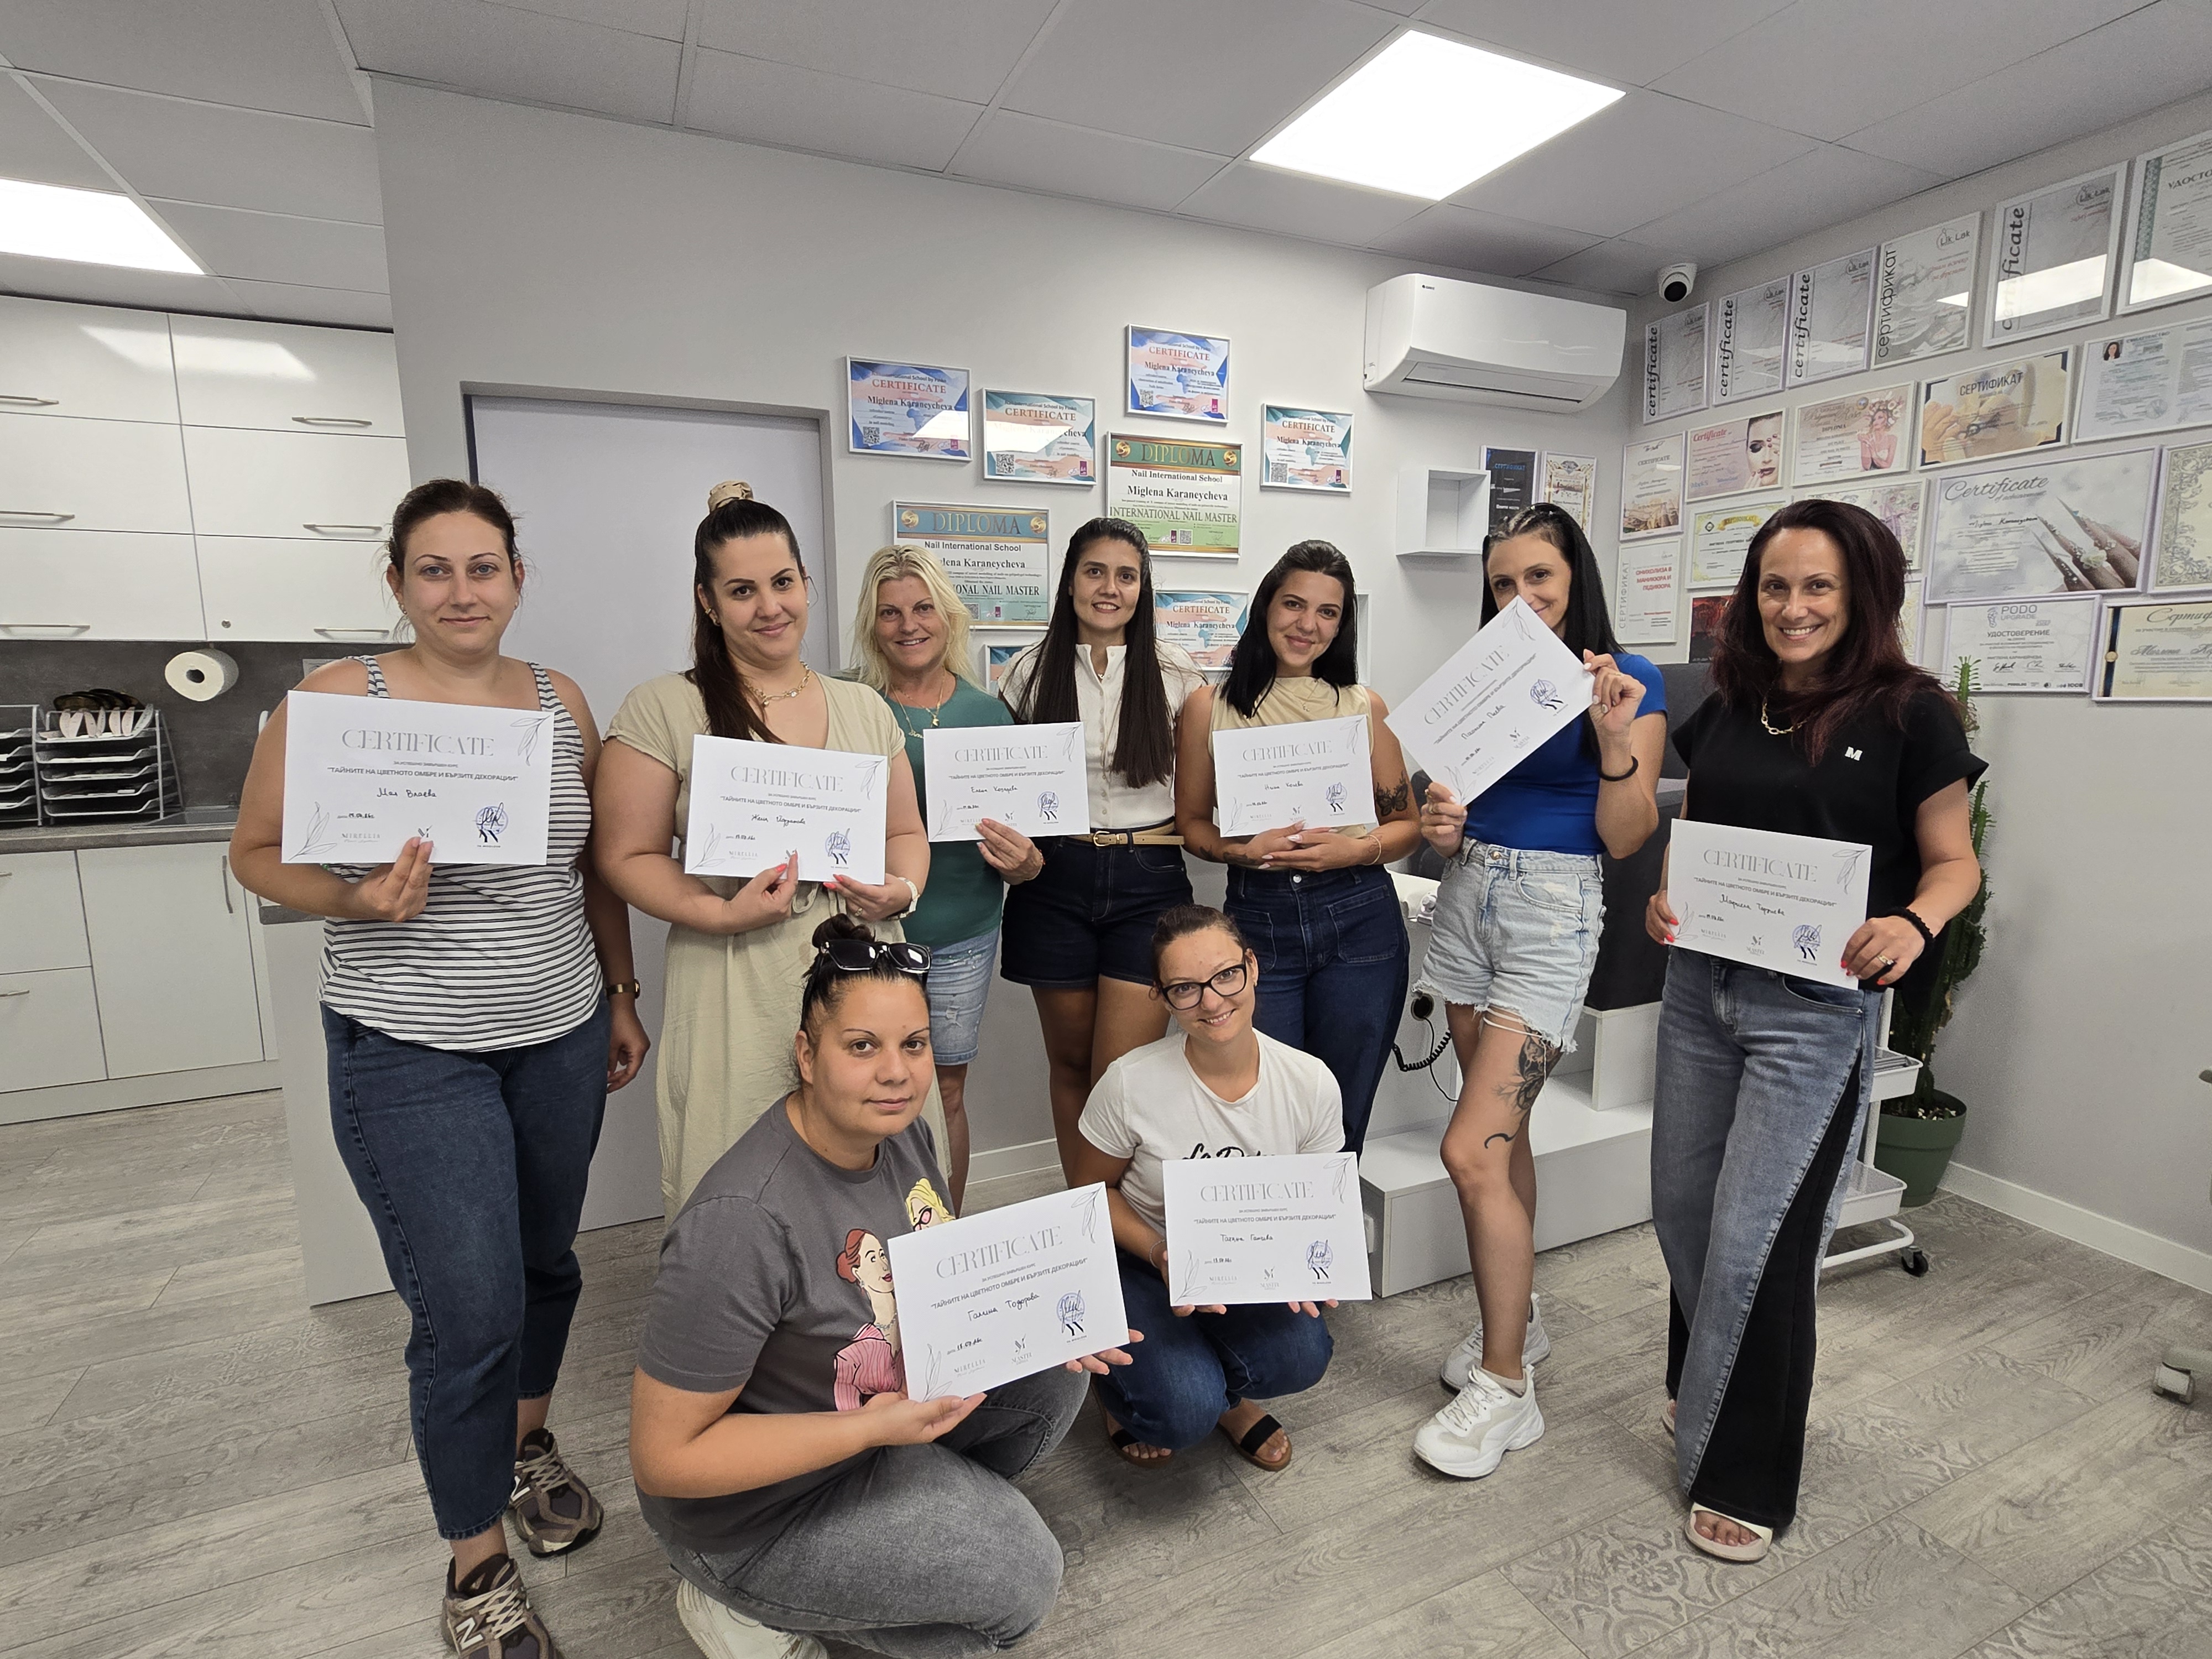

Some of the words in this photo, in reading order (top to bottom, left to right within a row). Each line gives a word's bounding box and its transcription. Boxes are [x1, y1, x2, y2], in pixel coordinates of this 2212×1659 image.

[1878, 250, 1897, 358] сертификат
[1793, 274, 1811, 378] certificate
[1149, 346, 1210, 361] CERTIFICATE
[1720, 299, 1734, 397] certificate
[1145, 361, 1170, 371] Miglena
[1646, 326, 1658, 418] certificate
[872, 379, 946, 394] CERTIFICATE
[1959, 372, 2024, 396] СЕРТИФИКАТ
[868, 395, 898, 405] Miglena
[1005, 408, 1076, 421] CERTIFICATE
[1282, 420, 1335, 433] CERTIFICATE
[1693, 429, 1728, 442] Certificate
[1141, 444, 1215, 467] DIPLOMA
[1637, 455, 1671, 466] CERTIFICATE
[1131, 469, 1147, 478] Nail
[1149, 470, 1197, 481] International
[1199, 474, 1223, 483] School
[1128, 485, 1164, 498] Miglena
[1166, 488, 1228, 502] Karaneycheva
[1945, 477, 2049, 501] Certificate
[1110, 507, 1180, 520] INTERNATIONAL
[1183, 511, 1203, 521] NAIL
[1205, 512, 1238, 523] MASTER
[933, 512, 1021, 535] DIPLOMA
[942, 542, 992, 551] International
[994, 544, 1021, 552] School
[964, 558, 1026, 570] Karaneycheva
[982, 585, 1003, 595] NAIL
[1006, 586, 1040, 596] MASTER
[1619, 562, 1629, 629] СЕРТИФИКАТ
[1173, 605, 1230, 614] CERTIFICATE
[2001, 604, 2038, 614] PODO
[1987, 629, 2051, 638] УДОСТОВЕРЕНИЕ
[1425, 645, 1509, 724] CERTIFICATE
[342, 730, 494, 756] CERTIFICATE
[1243, 740, 1332, 761] CERTIFICATE
[954, 745, 1047, 761] CERTIFICATE
[1845, 746, 1863, 761] M
[731, 766, 843, 792] CERTIFICATE
[1703, 850, 1817, 881] CERTIFICATE
[1201, 1182, 1313, 1201] CERTIFICATE
[936, 1226, 1062, 1278] CERTIFICATE
[970, 1284, 1000, 1297] ЦВЕТНОТО
[1001, 1277, 1020, 1287] ОМБРЕ
[1026, 1268, 1050, 1280] БЪРЗИТЕ
[967, 1307, 998, 1321] Галина
